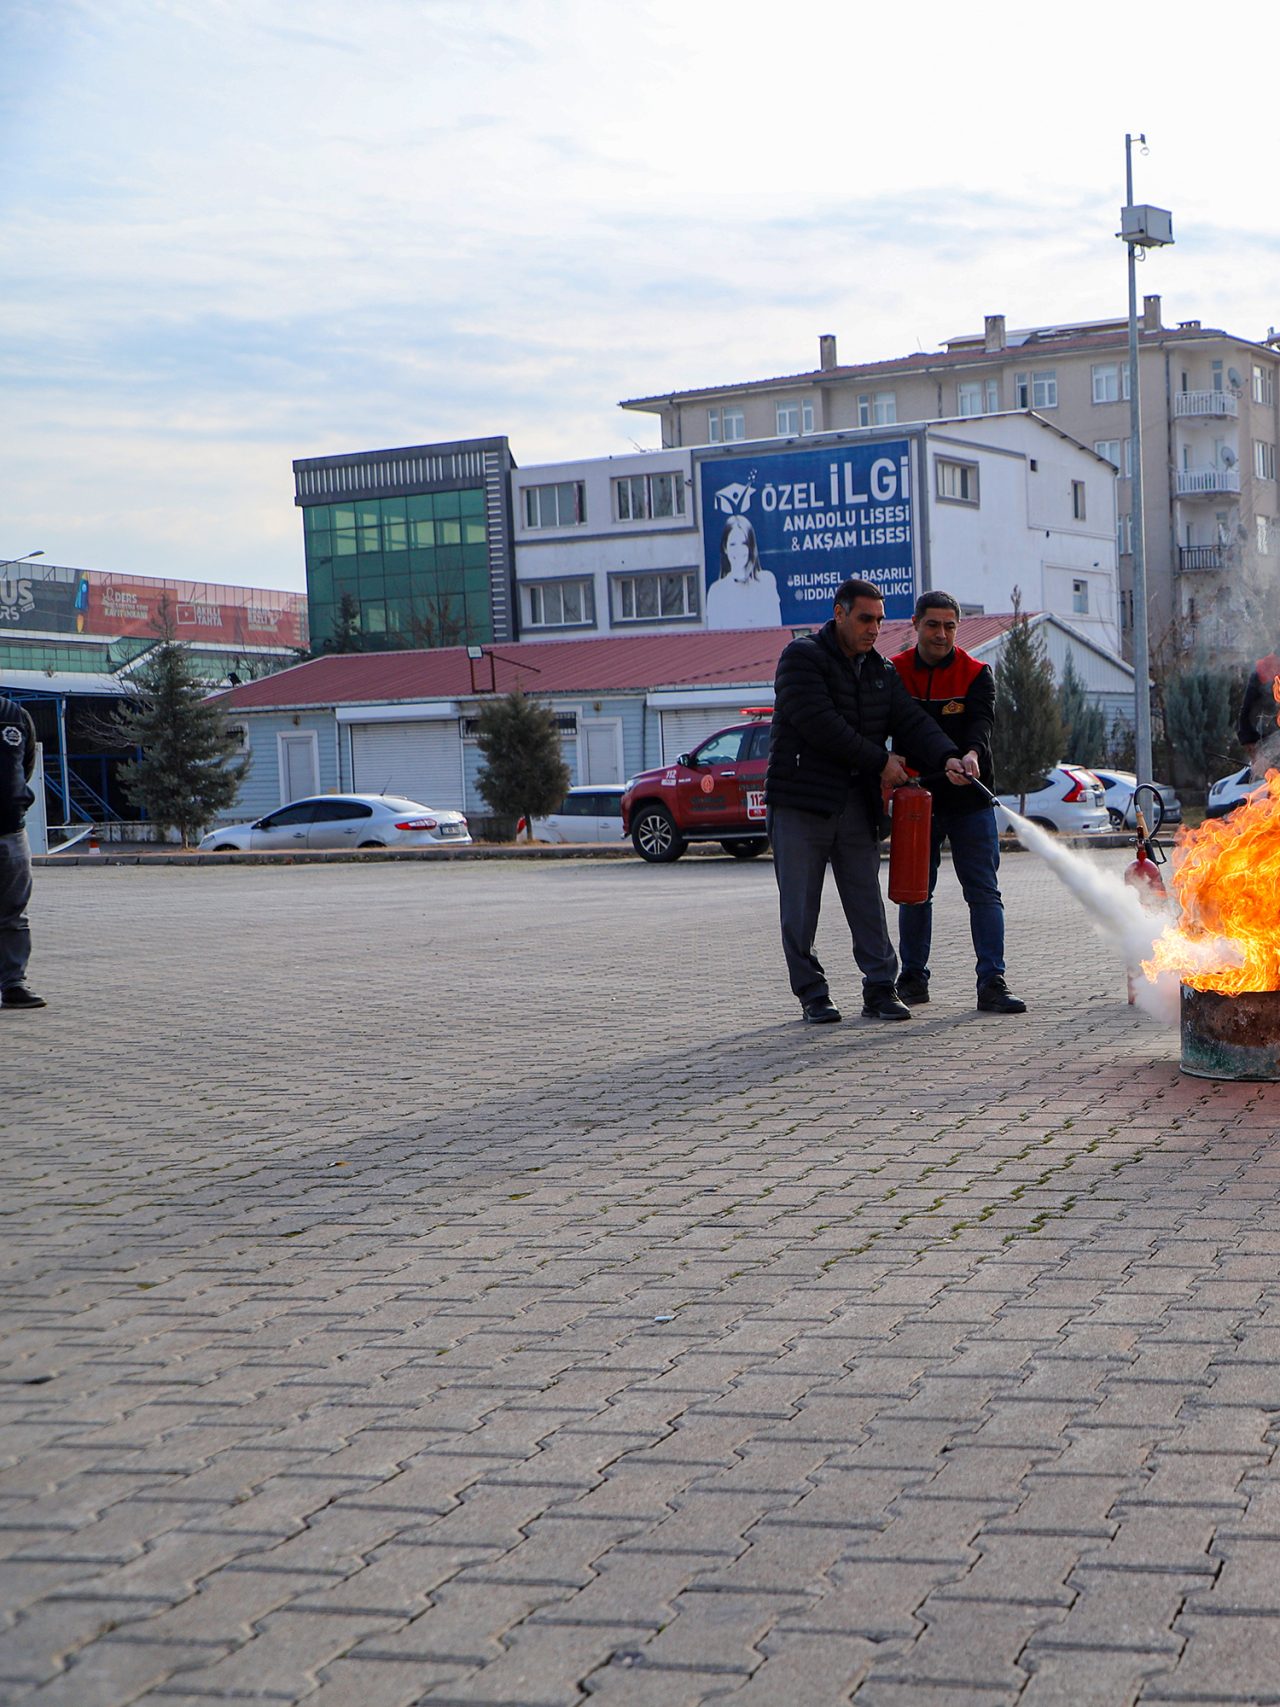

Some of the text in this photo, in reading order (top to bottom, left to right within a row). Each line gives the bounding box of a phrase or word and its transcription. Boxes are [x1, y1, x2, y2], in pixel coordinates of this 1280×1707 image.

[761, 455, 910, 512] ÖZEL İLGİ
[783, 505, 910, 532] ANADOLU LİSESİ
[791, 526, 911, 551] & AKŞAM LİSESİ
[666, 769, 677, 779] 112
